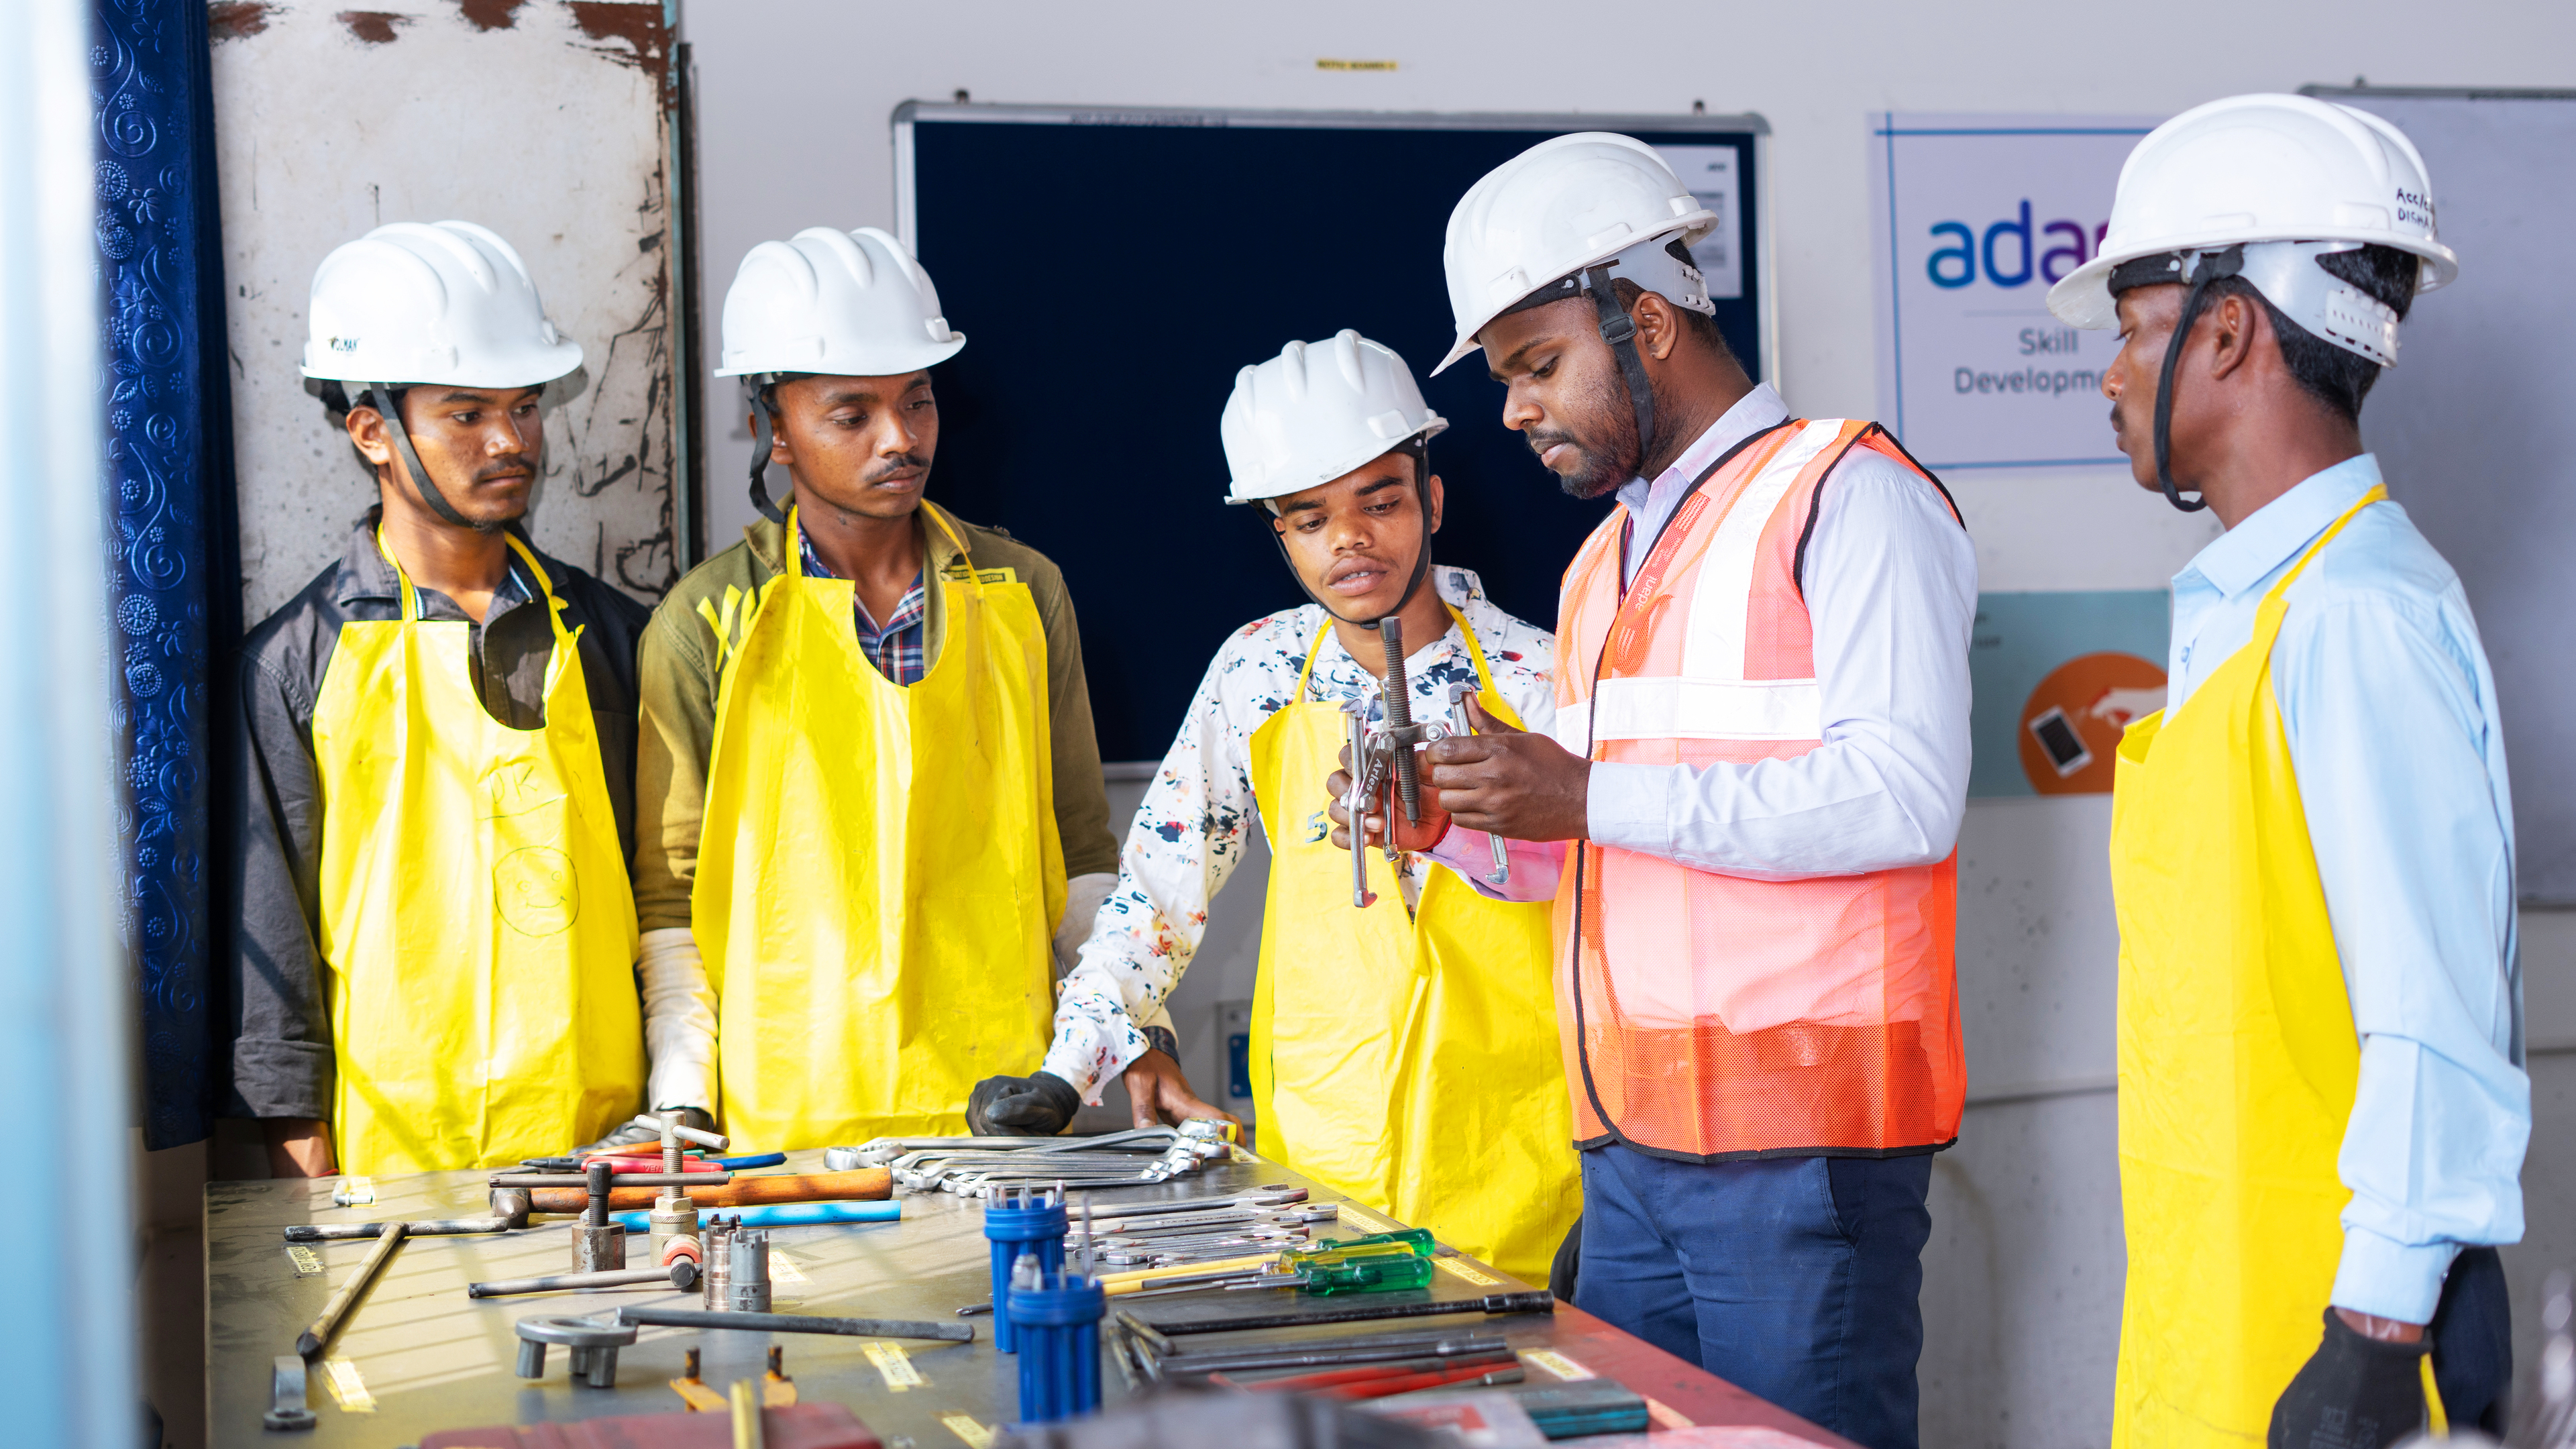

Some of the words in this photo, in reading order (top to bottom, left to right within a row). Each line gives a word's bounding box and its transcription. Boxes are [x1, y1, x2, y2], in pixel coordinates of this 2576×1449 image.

[1927, 199, 2110, 289] ada
[2019, 328, 2078, 355] Skill
[1955, 366, 2106, 397] Developm
[1634, 576, 1657, 612] adani
[1366, 757, 1383, 793] Aries
[1305, 810, 1328, 843] 5
[643, 1165, 664, 1173] VEN
